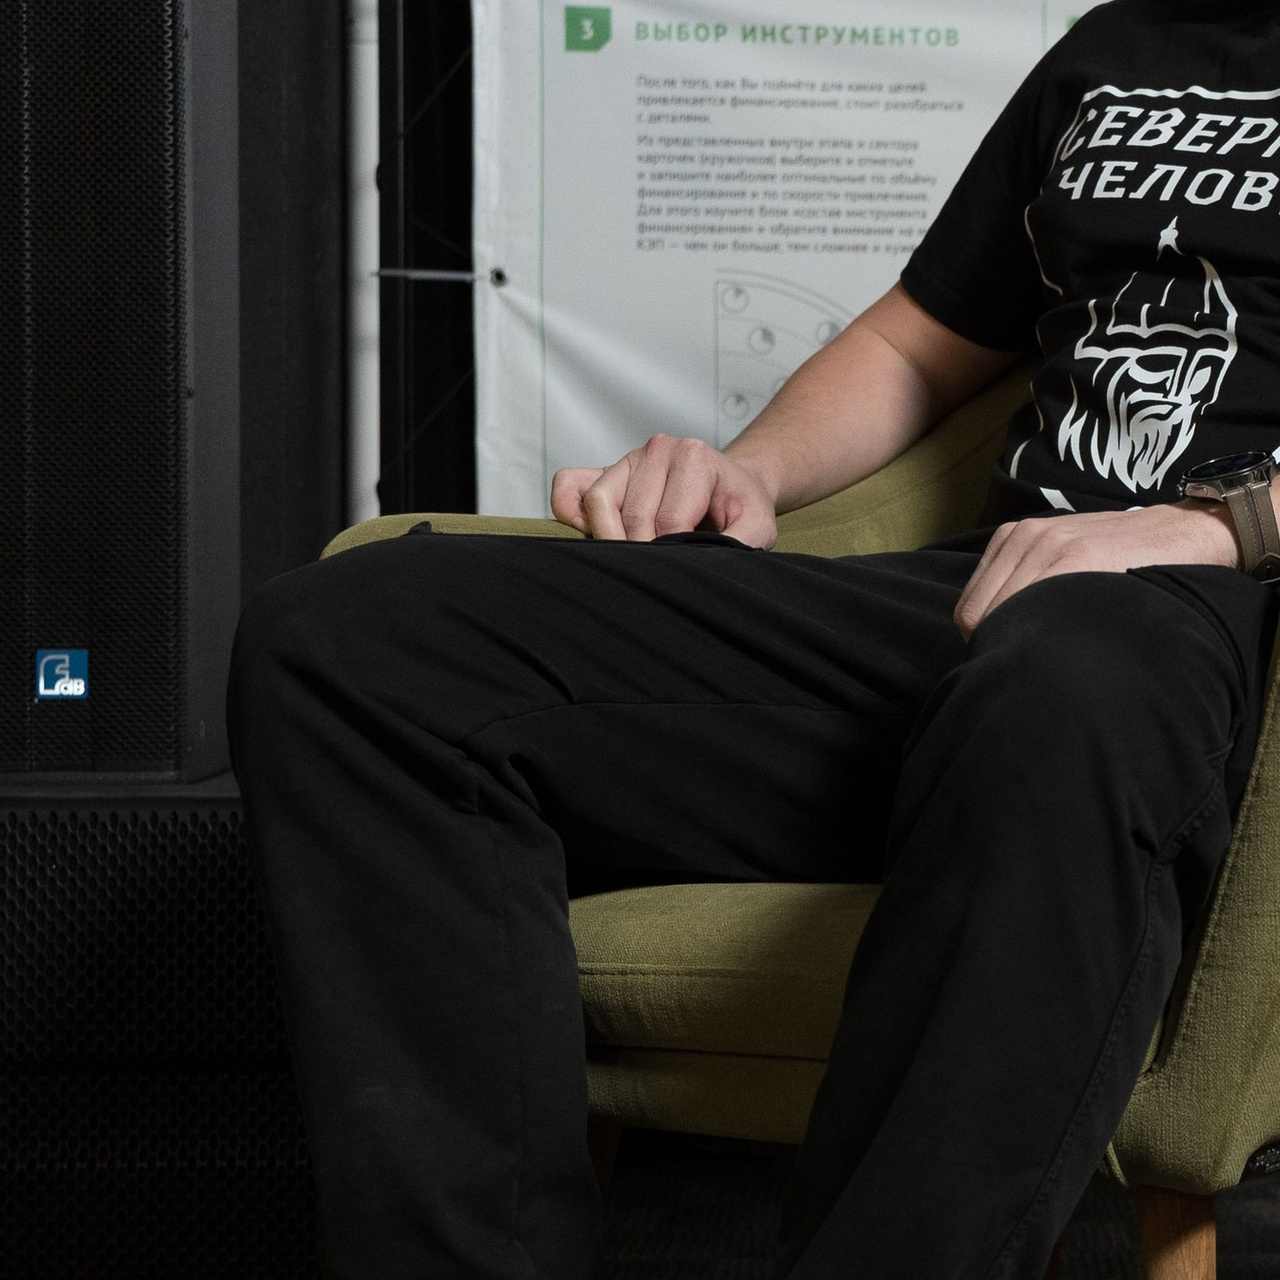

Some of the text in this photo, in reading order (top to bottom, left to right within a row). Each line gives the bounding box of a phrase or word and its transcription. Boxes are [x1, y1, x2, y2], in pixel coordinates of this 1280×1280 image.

[578, 20, 961, 48] 3 ВЫБОР ИНСТРУМЕНТОВ
